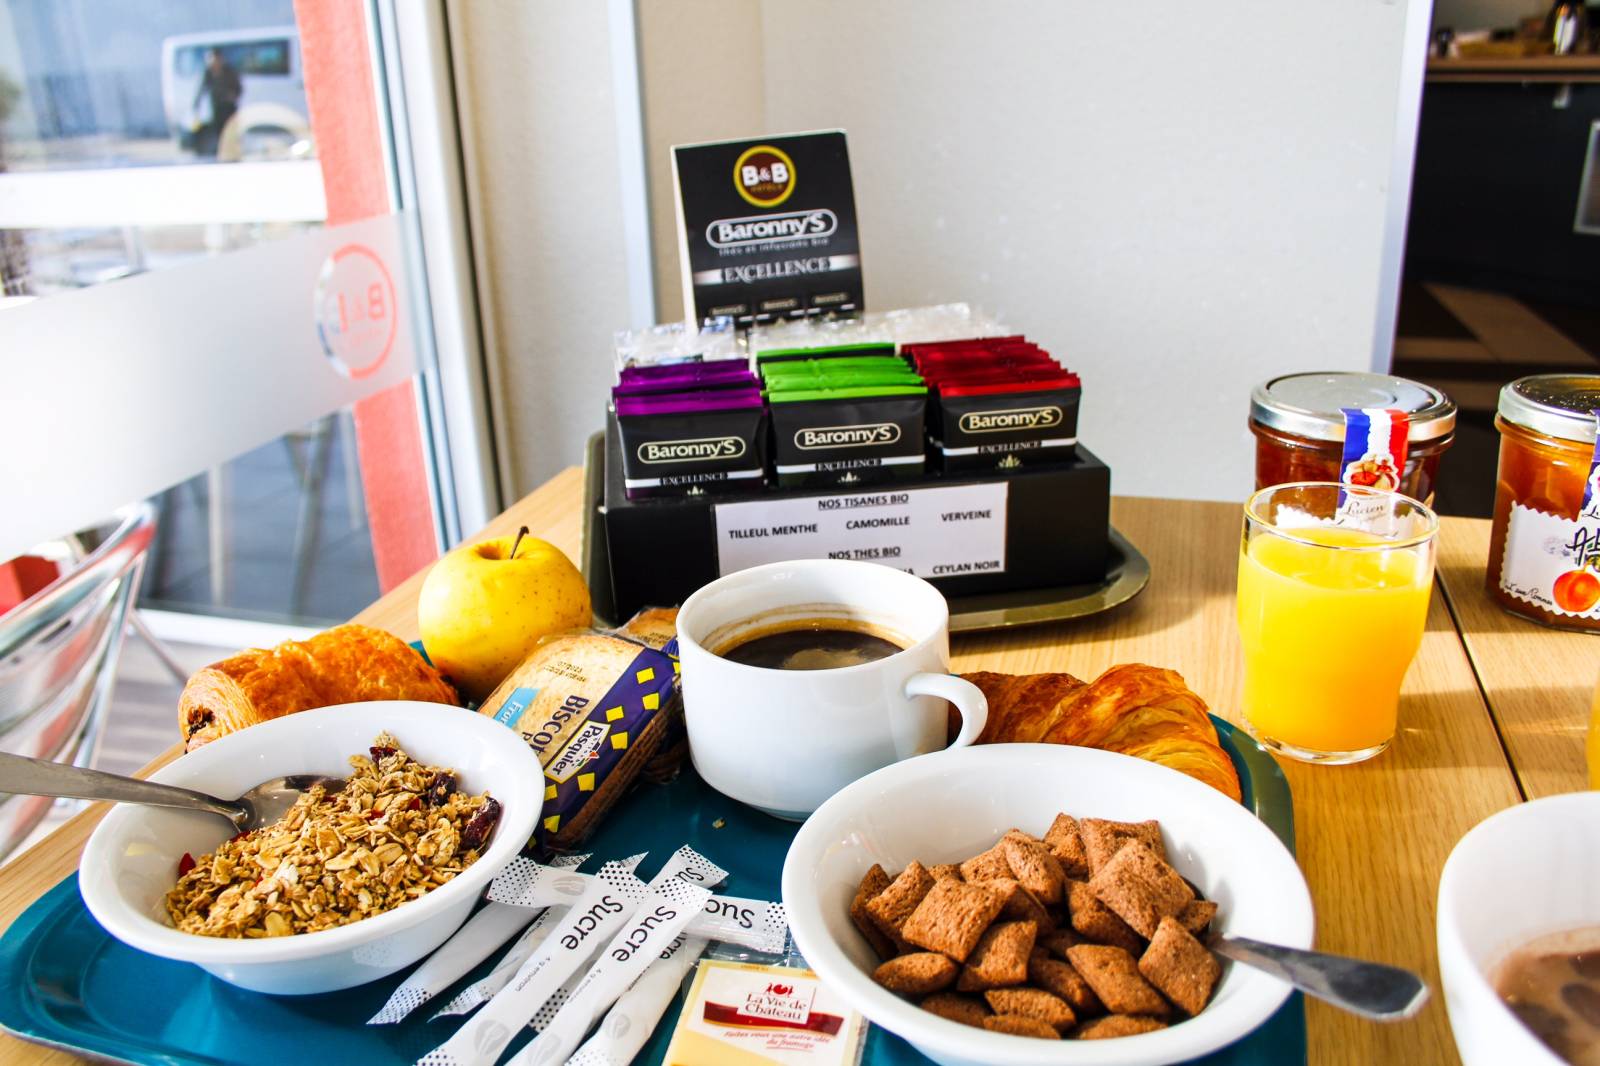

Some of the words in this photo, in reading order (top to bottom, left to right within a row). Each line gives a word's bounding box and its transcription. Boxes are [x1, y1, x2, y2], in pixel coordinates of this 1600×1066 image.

[742, 162, 789, 187] B&B
[718, 213, 827, 243] Baronny'S
[725, 256, 831, 284] EXCELLENCE
[969, 409, 1054, 429] Baronny'S
[804, 426, 892, 446] Baronny'S
[648, 439, 737, 460] Baronny'S
[979, 440, 1040, 454] EXCELLENCE
[817, 458, 881, 472] EXCELLENCE
[662, 472, 727, 486] EXCELLENCE
[818, 499, 841, 509] NOS
[844, 495, 888, 507] TISANES
[891, 493, 910, 503] BIO
[846, 516, 911, 530] CAMOMILLE
[941, 509, 992, 521] VERVEINE
[729, 528, 769, 539] TILLEUL
[772, 523, 818, 536] MENTHE
[828, 550, 851, 560] NOS
[854, 548, 880, 559] THES
[883, 546, 902, 556] BIO
[932, 563, 972, 574] CEYLAN
[974, 560, 1000, 571] NOIR
[552, 725, 603, 775] Pasquier
[561, 895, 624, 950] Sucre
[612, 906, 677, 961] Sucre
[747, 993, 763, 1003] La
[766, 996, 786, 1007] Vie
[789, 1000, 807, 1010] de
